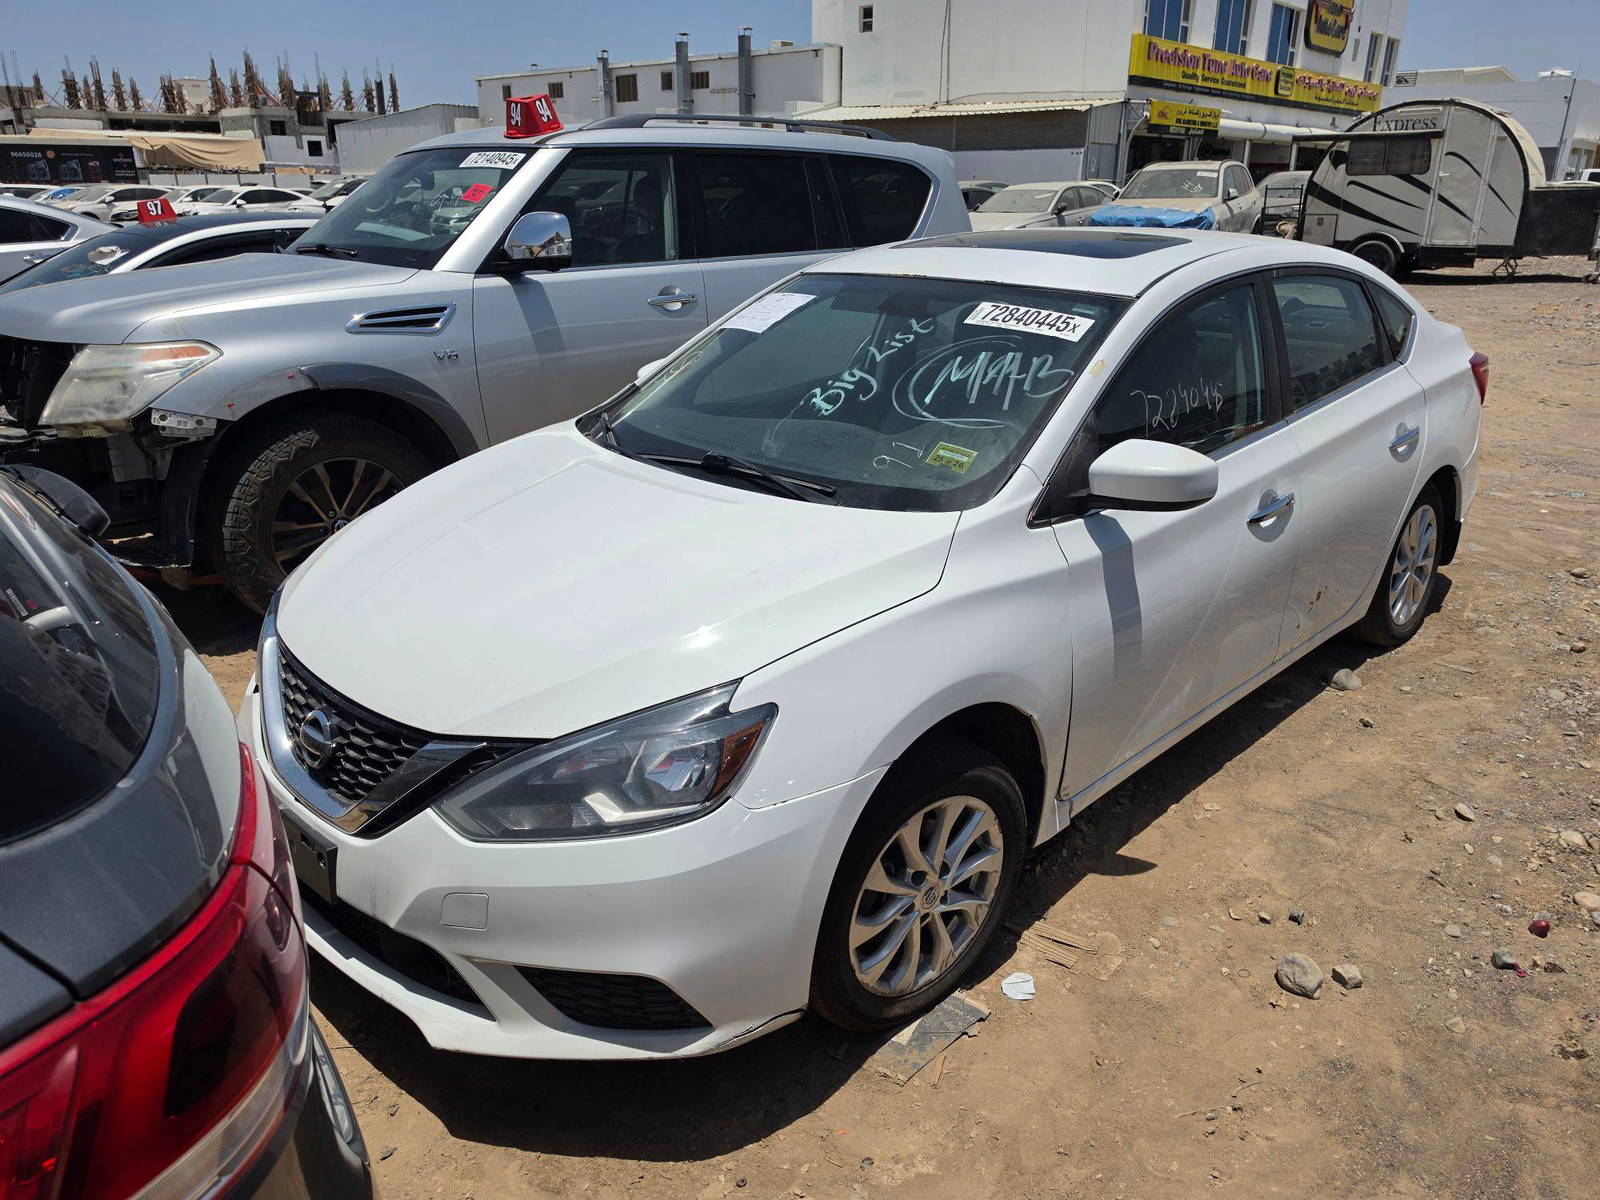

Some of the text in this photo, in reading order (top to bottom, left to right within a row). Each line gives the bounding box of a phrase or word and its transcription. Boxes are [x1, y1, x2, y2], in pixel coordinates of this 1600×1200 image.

[1147, 41, 1200, 70] Precision
[1201, 53, 1228, 74] Tune
[1228, 58, 1250, 78] Auto
[1250, 63, 1273, 83] Care
[1181, 70, 1247, 88] Quality Service Guaranteed
[510, 102, 521, 127] 94
[535, 98, 553, 122] 94
[1373, 113, 1437, 131] Express
[146, 200, 163, 216] 97
[810, 318, 934, 416] Big List
